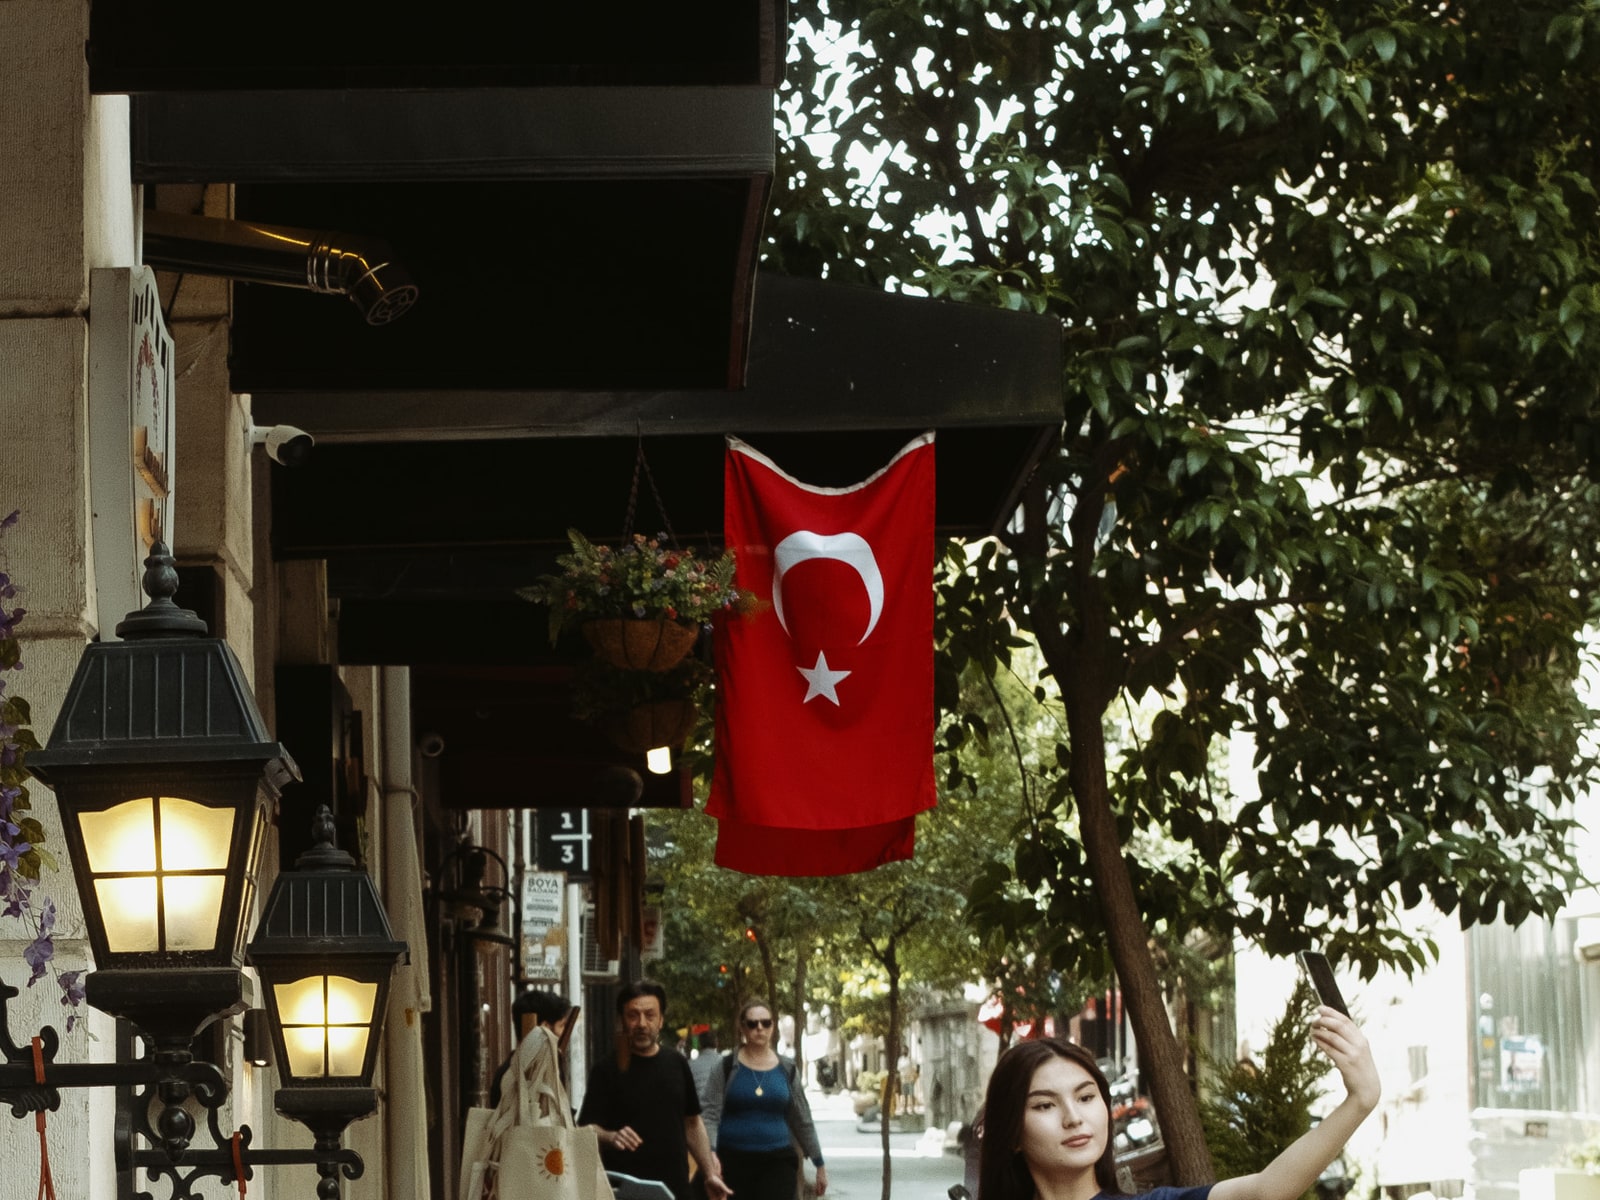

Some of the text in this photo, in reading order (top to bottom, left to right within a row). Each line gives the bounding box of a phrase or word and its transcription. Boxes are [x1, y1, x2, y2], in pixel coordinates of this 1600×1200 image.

[561, 812, 574, 829] 1
[561, 845, 574, 864] 3
[528, 878, 558, 888] BOYA
